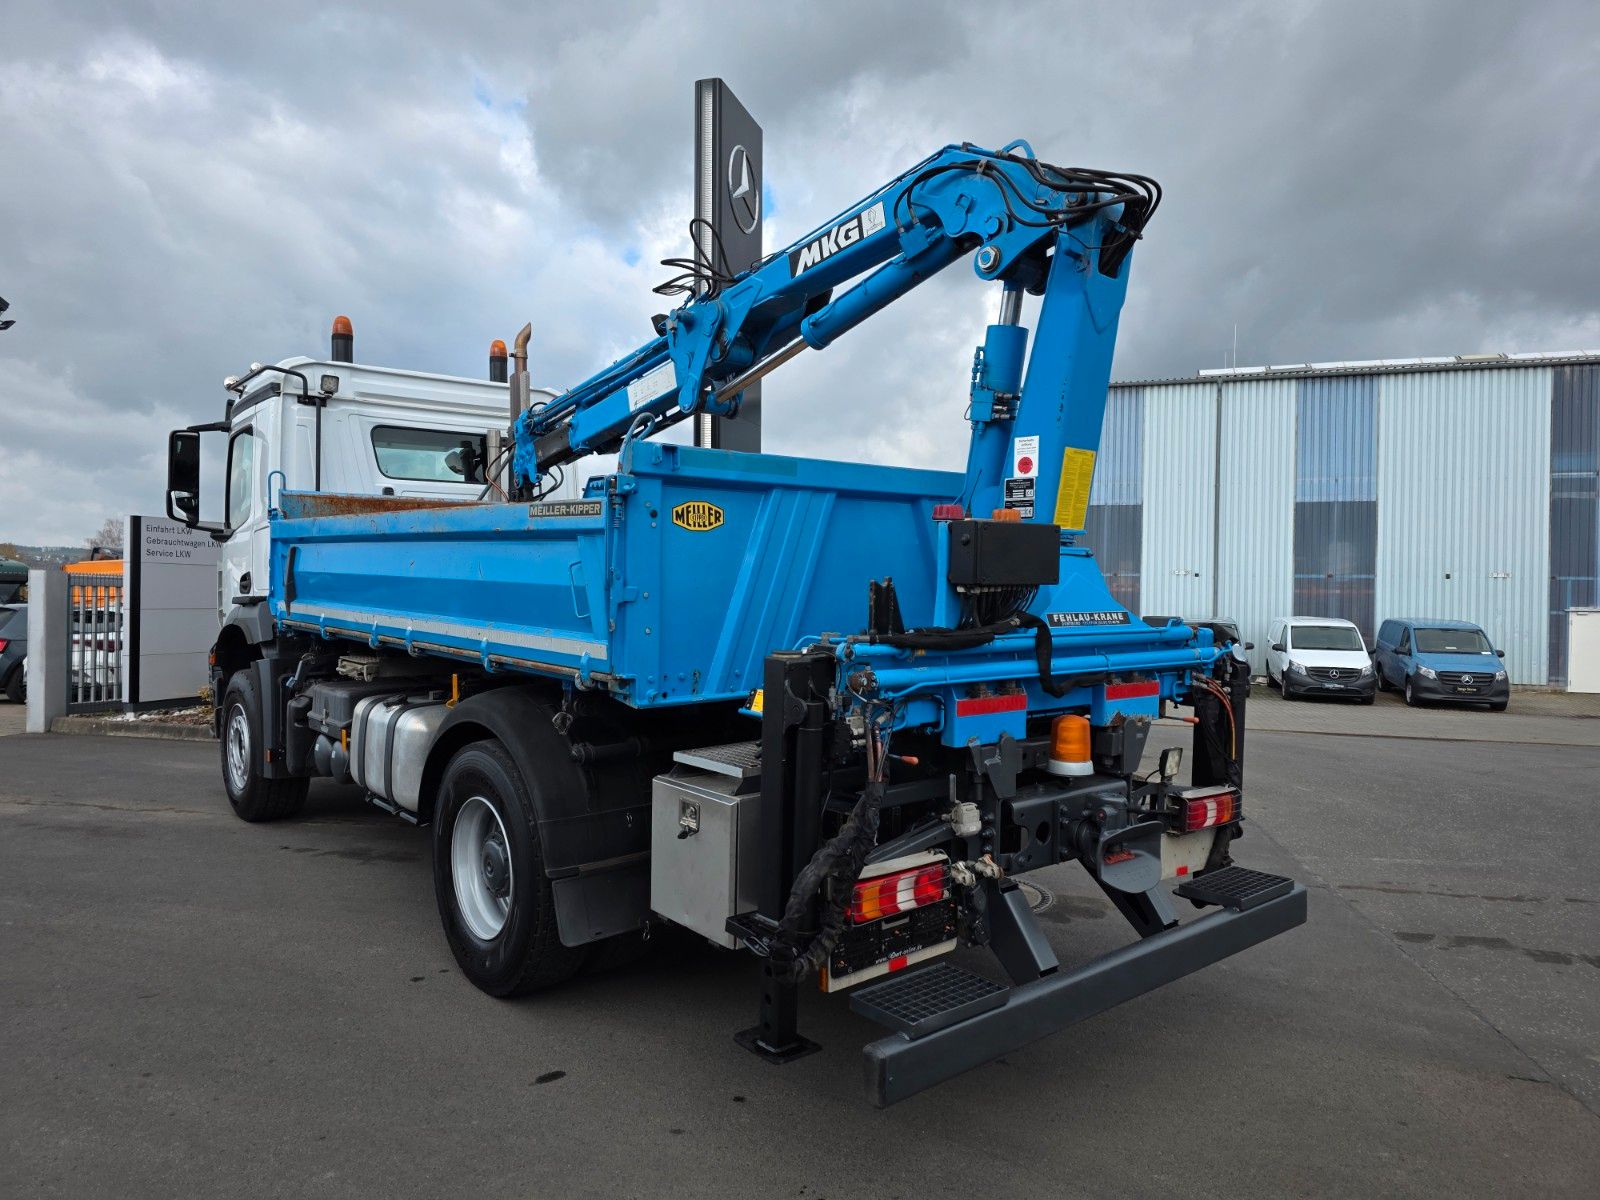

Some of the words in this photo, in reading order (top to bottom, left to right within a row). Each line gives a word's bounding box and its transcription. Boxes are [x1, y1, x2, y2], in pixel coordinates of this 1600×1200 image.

[796, 218, 860, 276] MKG
[530, 503, 601, 516] MEILLER-KIPPER
[675, 504, 722, 528] MEILLER
[146, 524, 175, 534] Einfahrt
[177, 526, 193, 535] LKW
[146, 536, 206, 548] Gebrauchtwagen
[207, 540, 222, 549] LKW
[146, 548, 174, 558] Service
[175, 549, 192, 558] LKW
[1053, 612, 1124, 622] FEHLAU-KRANE
